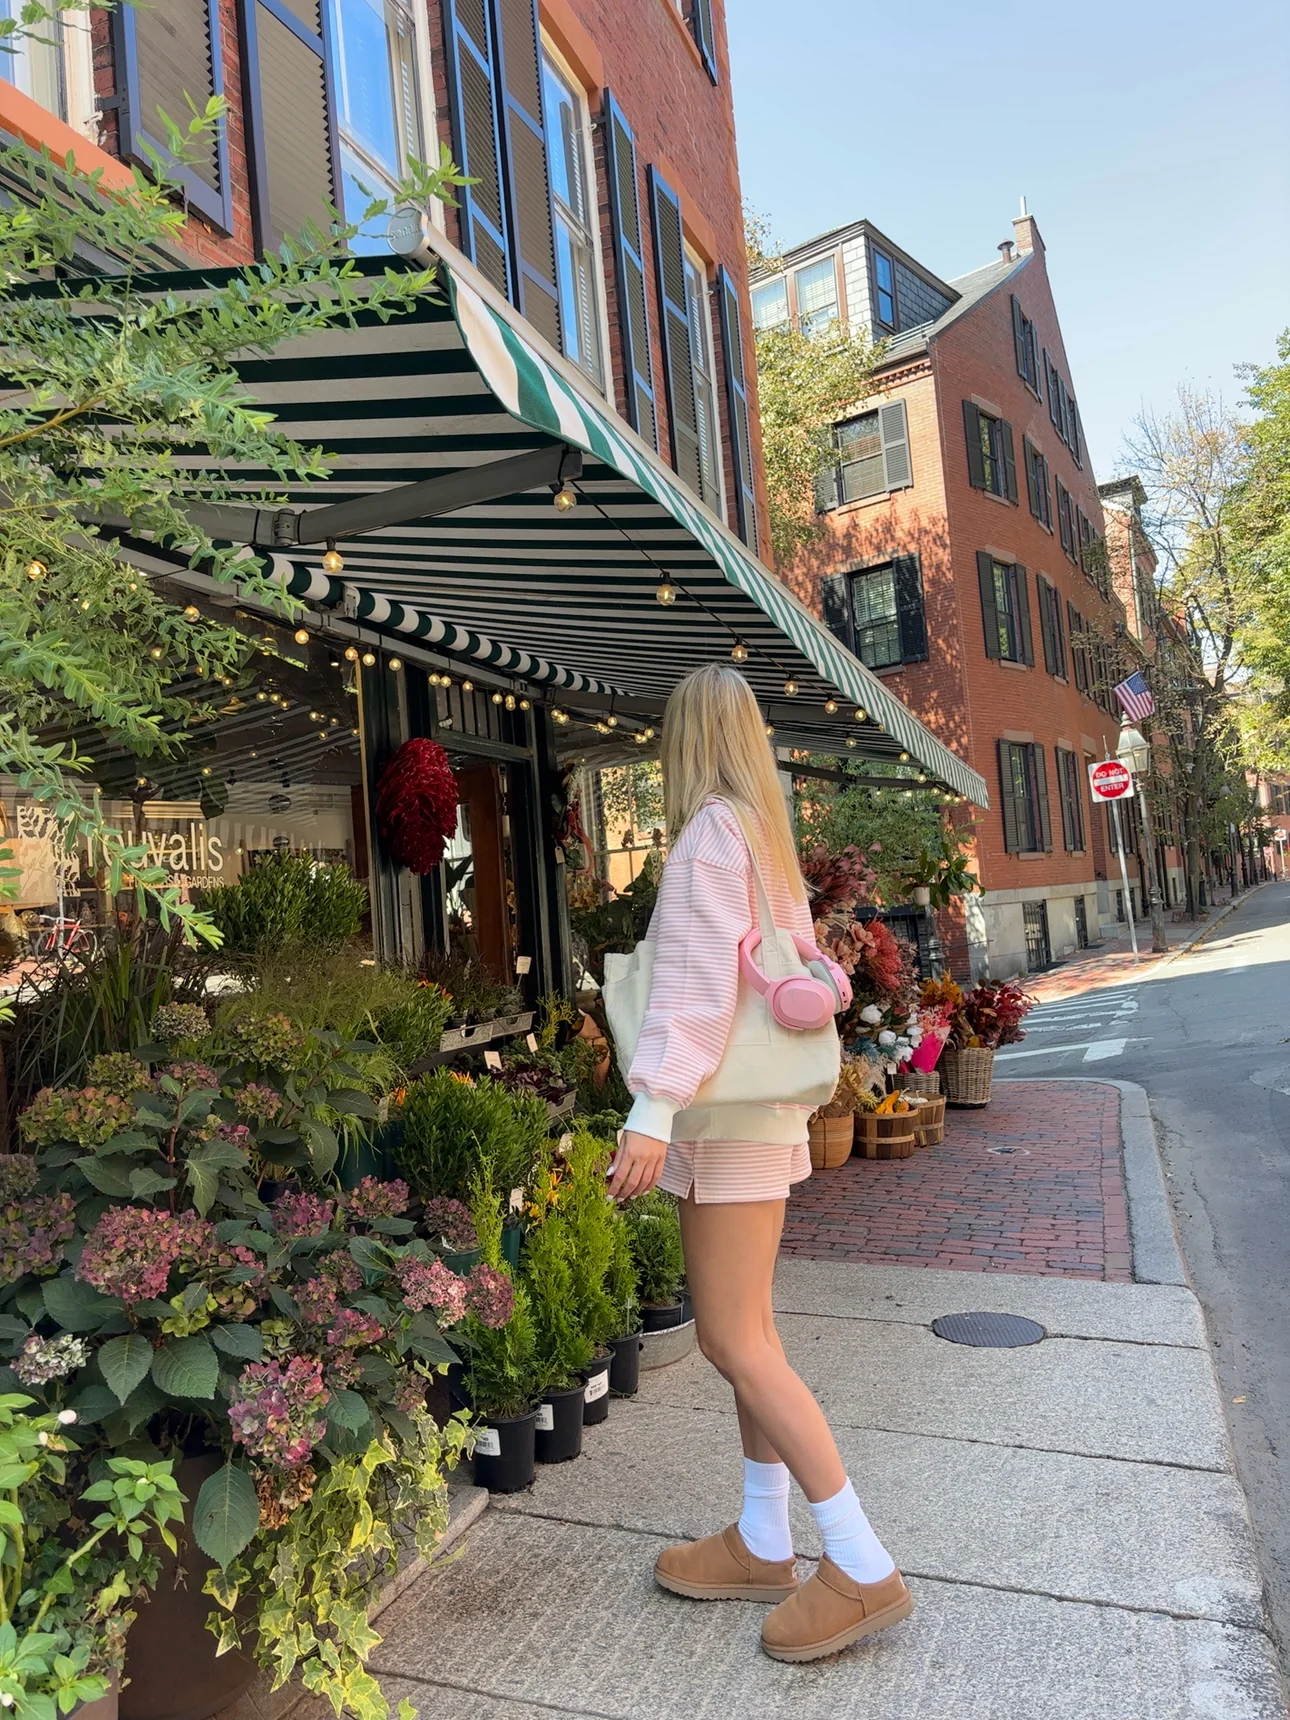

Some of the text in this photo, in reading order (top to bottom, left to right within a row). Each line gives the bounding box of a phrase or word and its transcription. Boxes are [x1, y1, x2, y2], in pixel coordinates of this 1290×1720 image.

[1109, 768, 1125, 776] NOT
[1100, 783, 1124, 792] ENTER
[185, 876, 225, 889] GARDENS
